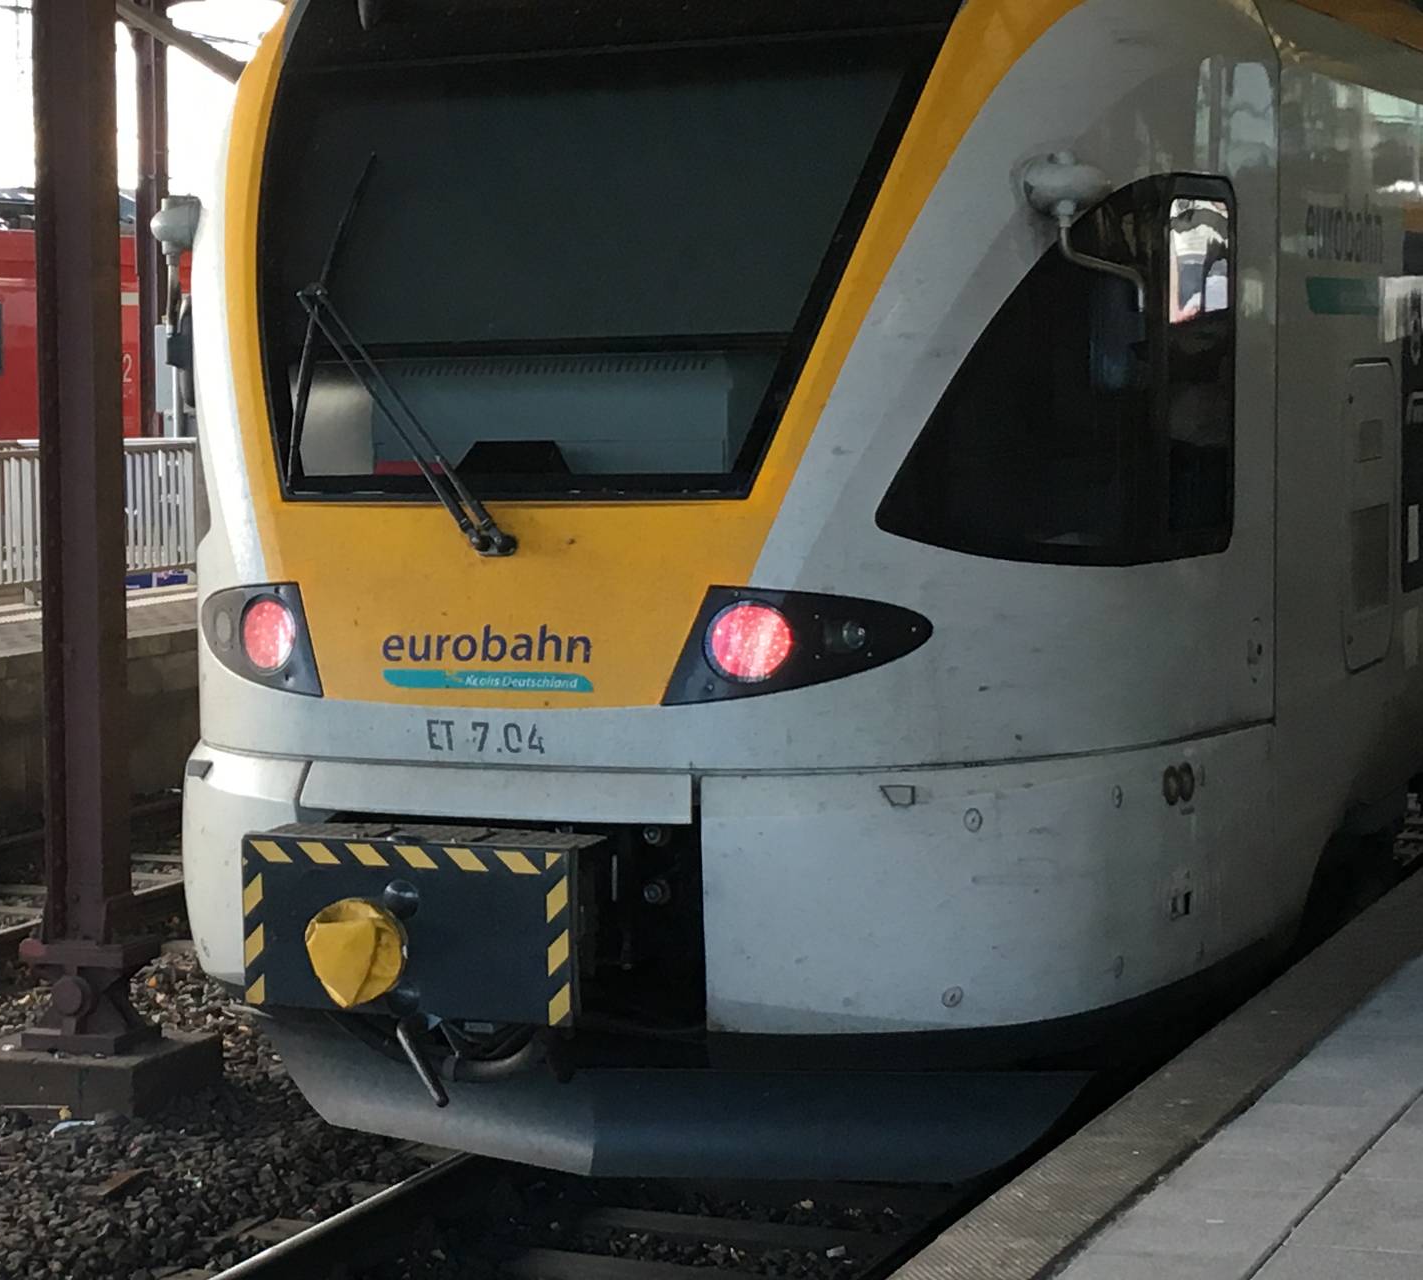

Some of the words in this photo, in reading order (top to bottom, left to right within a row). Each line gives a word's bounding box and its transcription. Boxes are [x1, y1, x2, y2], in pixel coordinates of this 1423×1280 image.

[122, 353, 134, 384] 2
[382, 623, 592, 664] eurobahn
[502, 675, 579, 690] Deutschland
[426, 718, 455, 751] ET
[471, 721, 546, 755] 7.04
